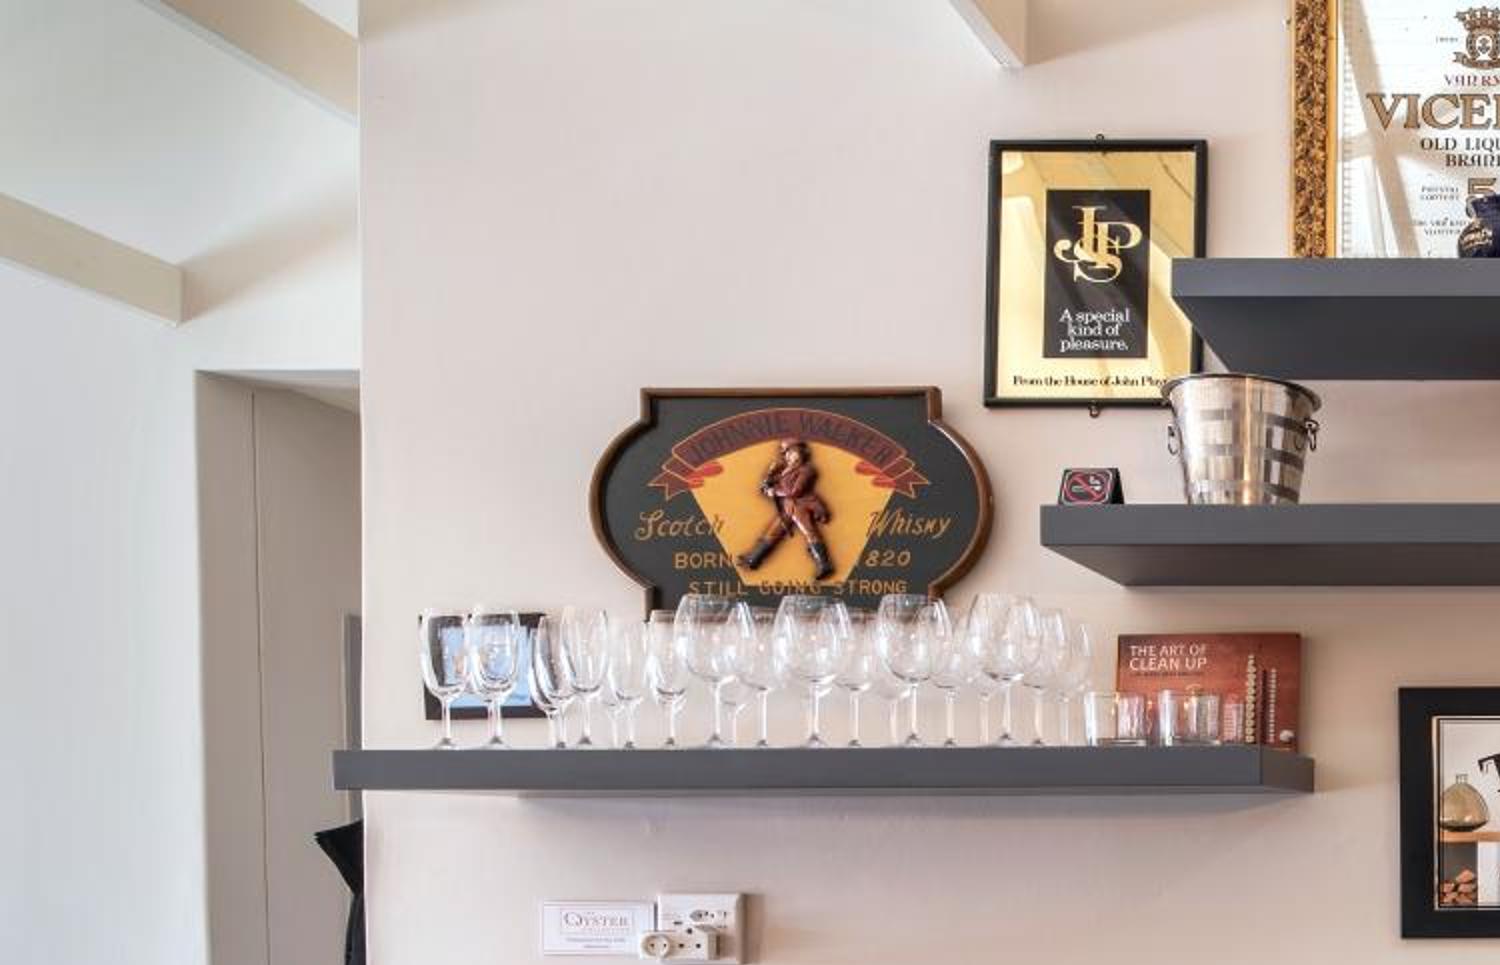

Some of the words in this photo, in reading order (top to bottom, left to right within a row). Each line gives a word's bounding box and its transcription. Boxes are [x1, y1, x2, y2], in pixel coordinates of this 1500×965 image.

[1420, 138, 1458, 151] OLD
[1059, 308, 1073, 323] A
[1075, 308, 1130, 326] special
[1067, 321, 1102, 337] kind
[1105, 321, 1122, 336] of
[1013, 374, 1042, 386] From
[1044, 374, 1063, 386] the
[1065, 374, 1099, 386] House
[1112, 374, 1138, 387] John
[634, 510, 726, 541] Scotch
[688, 580, 747, 596] STILL
[831, 580, 908, 595] STRONG
[1129, 645, 1156, 657] THE
[1159, 644, 1185, 656] ART
[1189, 643, 1207, 655] OF
[1129, 658, 1181, 672] CLEAN
[1185, 657, 1208, 669] UP
